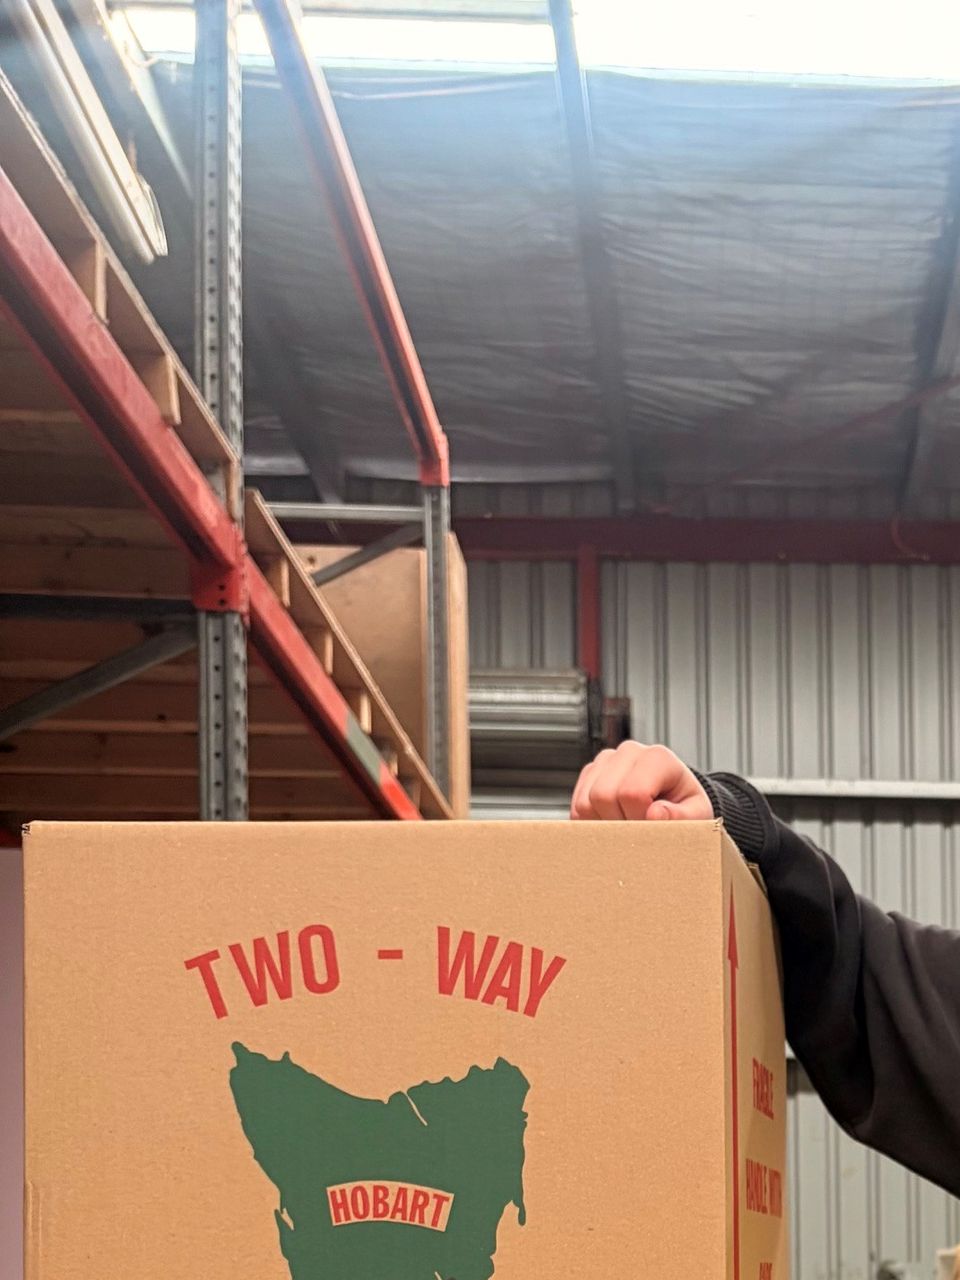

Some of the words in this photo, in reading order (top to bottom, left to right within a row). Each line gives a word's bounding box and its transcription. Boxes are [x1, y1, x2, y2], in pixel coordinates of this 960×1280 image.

[185, 924, 340, 1019] TWO
[437, 926, 566, 1018] WAY
[329, 1184, 450, 1231] HOBART
